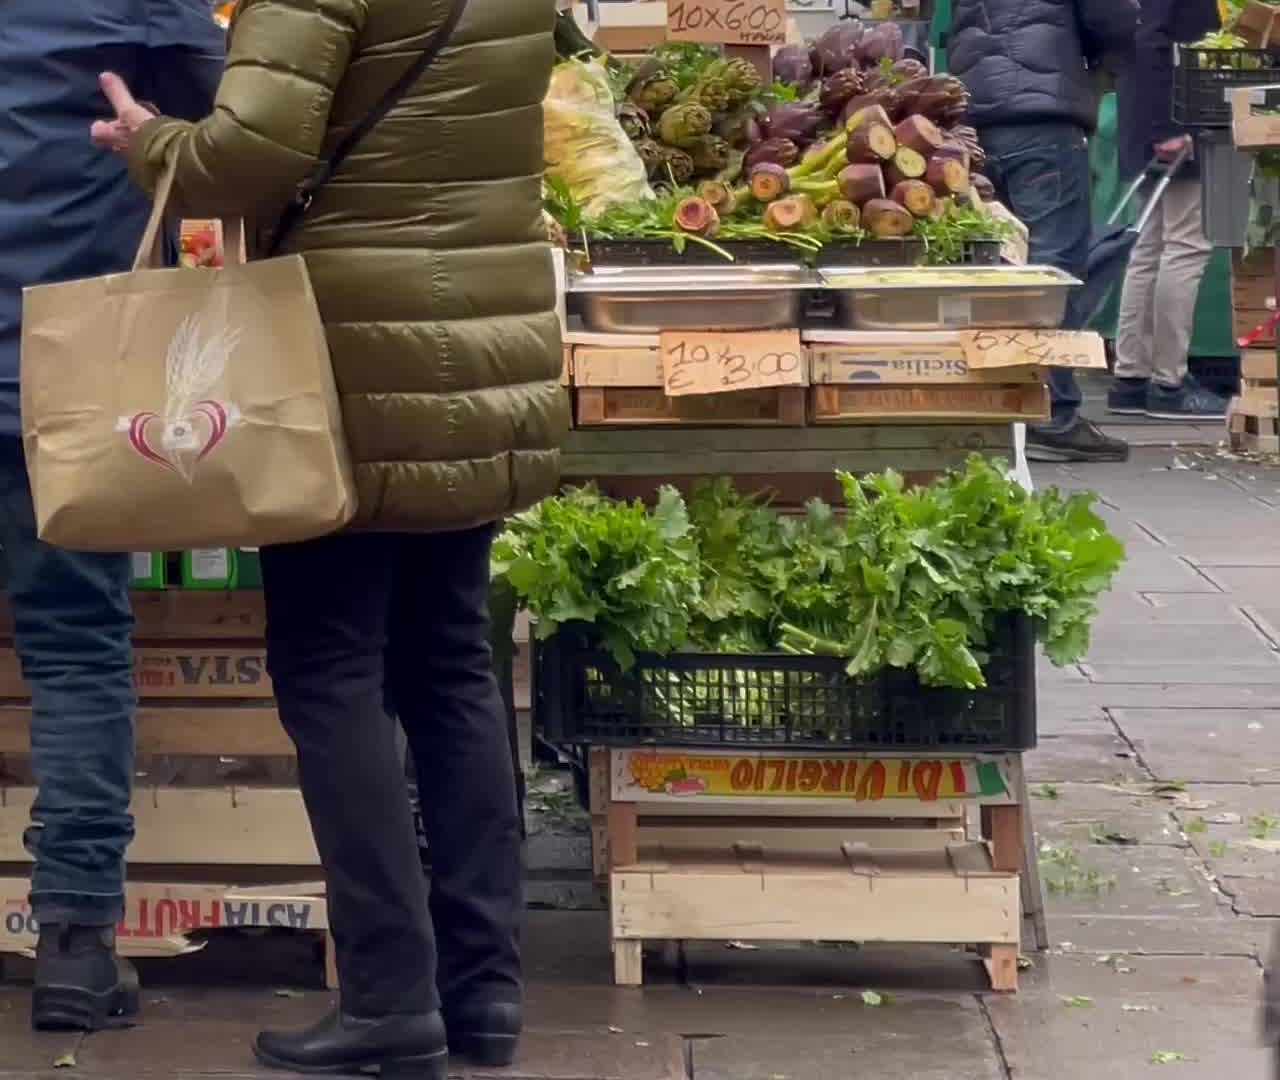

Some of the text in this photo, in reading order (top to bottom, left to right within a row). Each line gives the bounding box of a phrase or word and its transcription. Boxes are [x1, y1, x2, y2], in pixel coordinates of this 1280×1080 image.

[889, 358, 968, 377] Sicilia
[175, 654, 262, 686] STA
[730, 759, 946, 803] DI VIRGILIO
[116, 898, 225, 939] FRUTT
